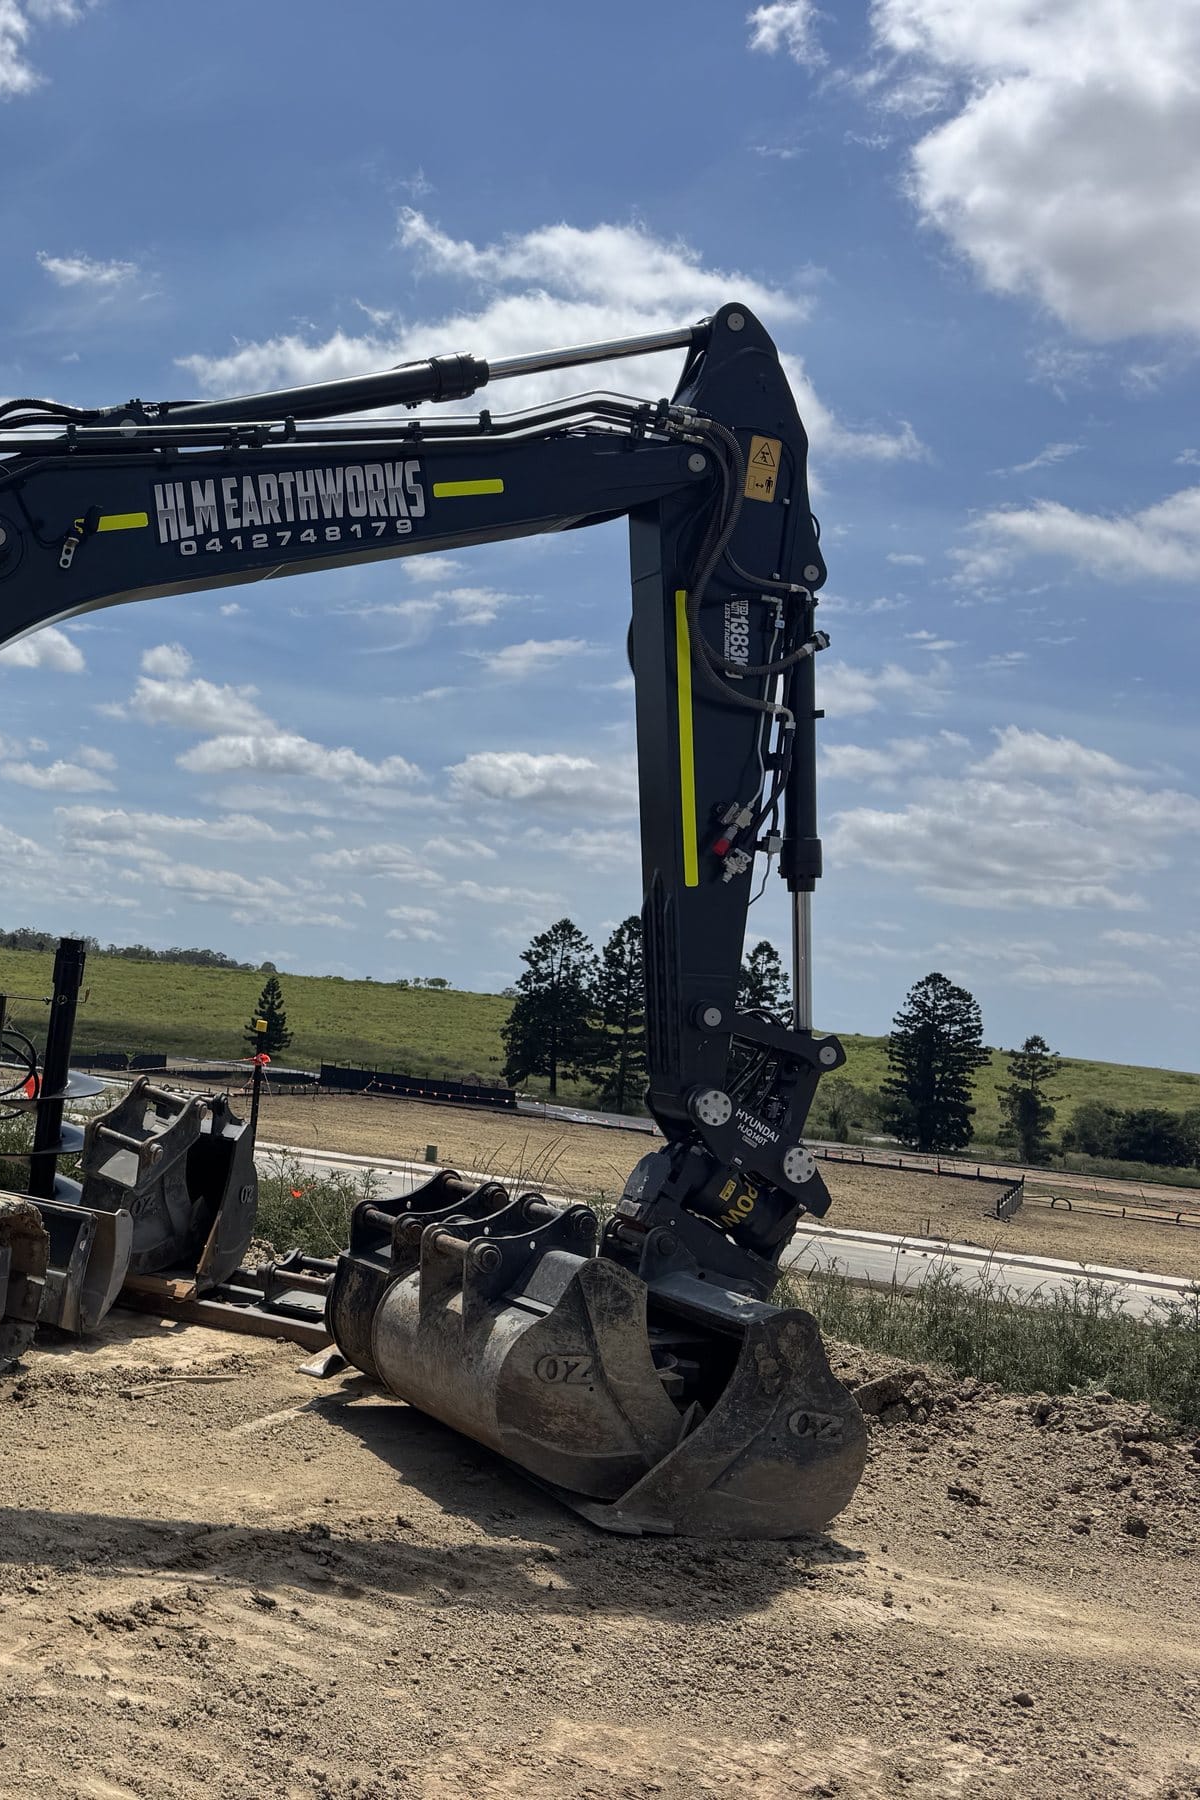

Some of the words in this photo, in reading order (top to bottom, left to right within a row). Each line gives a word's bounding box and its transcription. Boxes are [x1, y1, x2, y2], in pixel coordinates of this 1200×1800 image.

[154, 479, 219, 543] HLM
[221, 460, 426, 530] EARTHWORKS
[179, 519, 413, 556] 0412748179
[735, 1108, 780, 1143] HYUNDAI
[737, 1122, 768, 1146] HJQ140T
[536, 1353, 594, 1384] OZ
